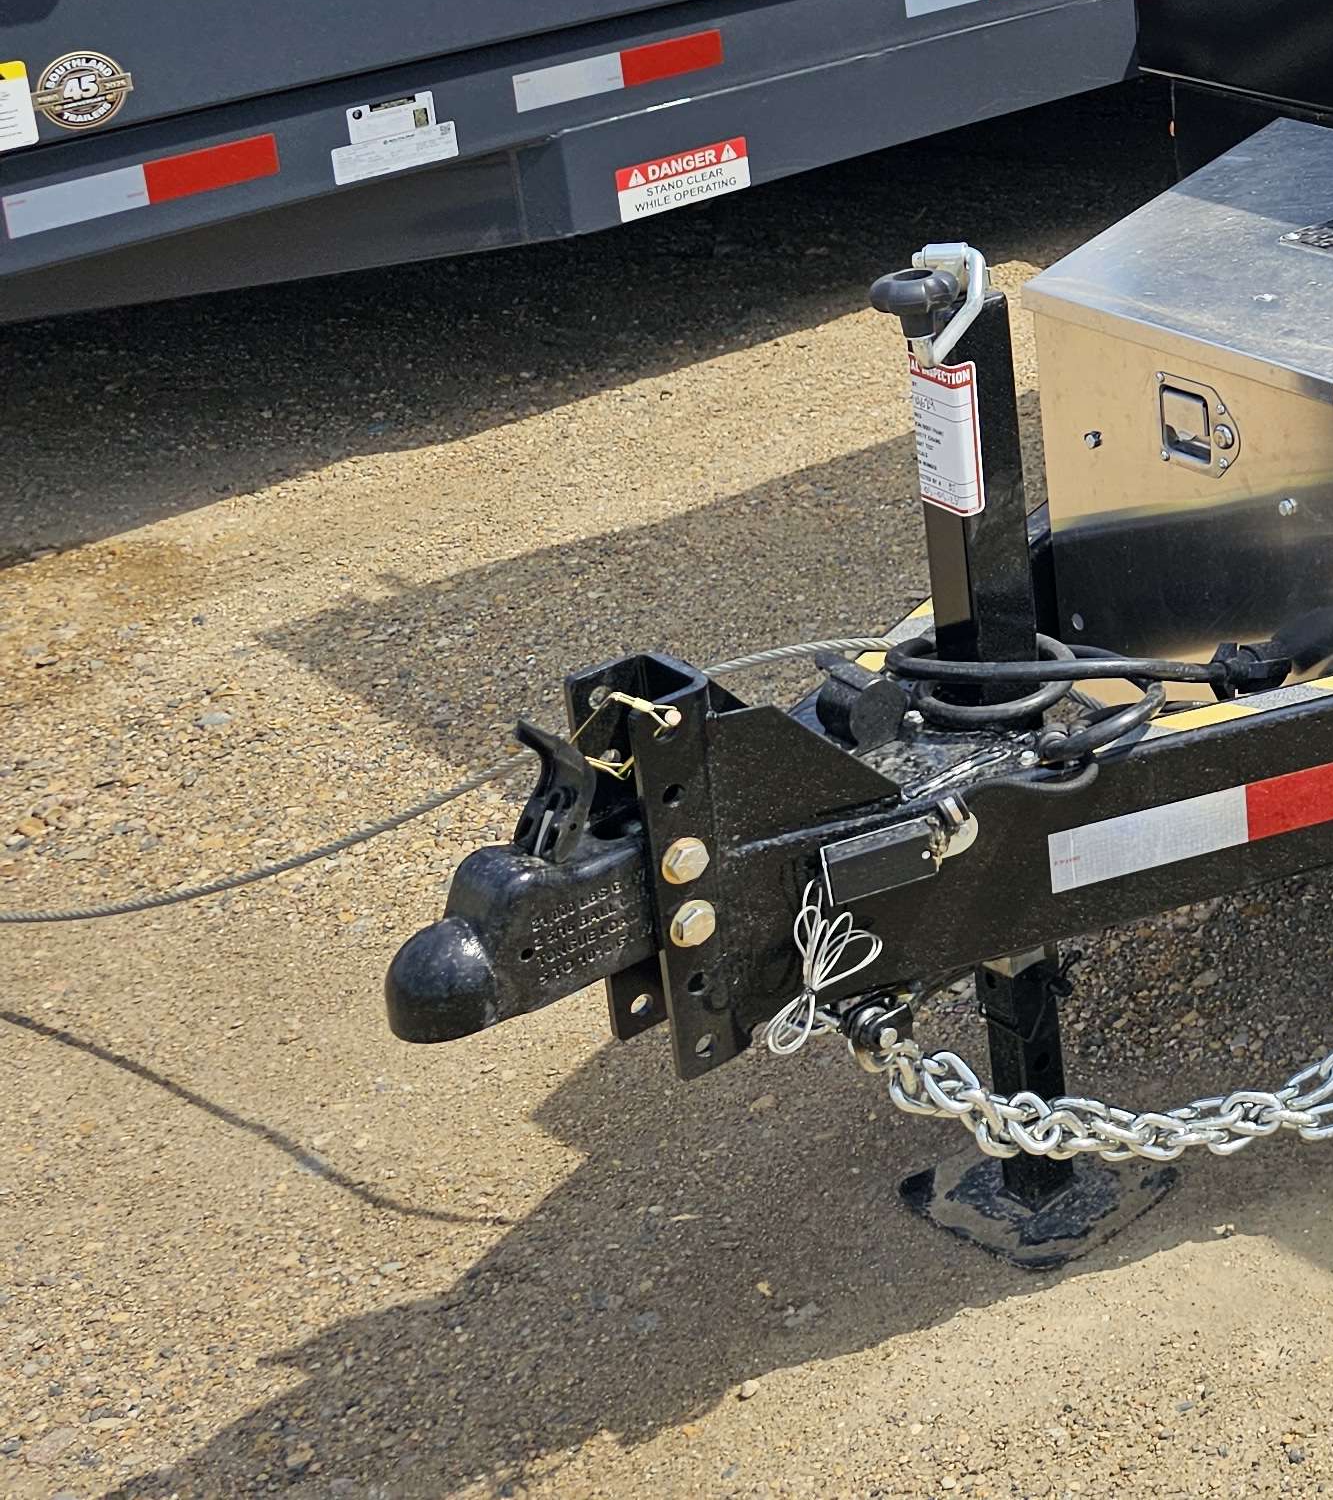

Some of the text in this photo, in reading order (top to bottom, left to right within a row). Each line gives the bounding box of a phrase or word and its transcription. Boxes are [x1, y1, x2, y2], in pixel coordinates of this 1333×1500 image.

[45, 57, 113, 89] SOUTHLAND
[63, 73, 99, 101] 45
[62, 101, 112, 122] TRAILERS
[647, 149, 717, 181] DANGER
[635, 176, 737, 212] WHILE OPERATING
[646, 167, 724, 197] STAND CLEAR
